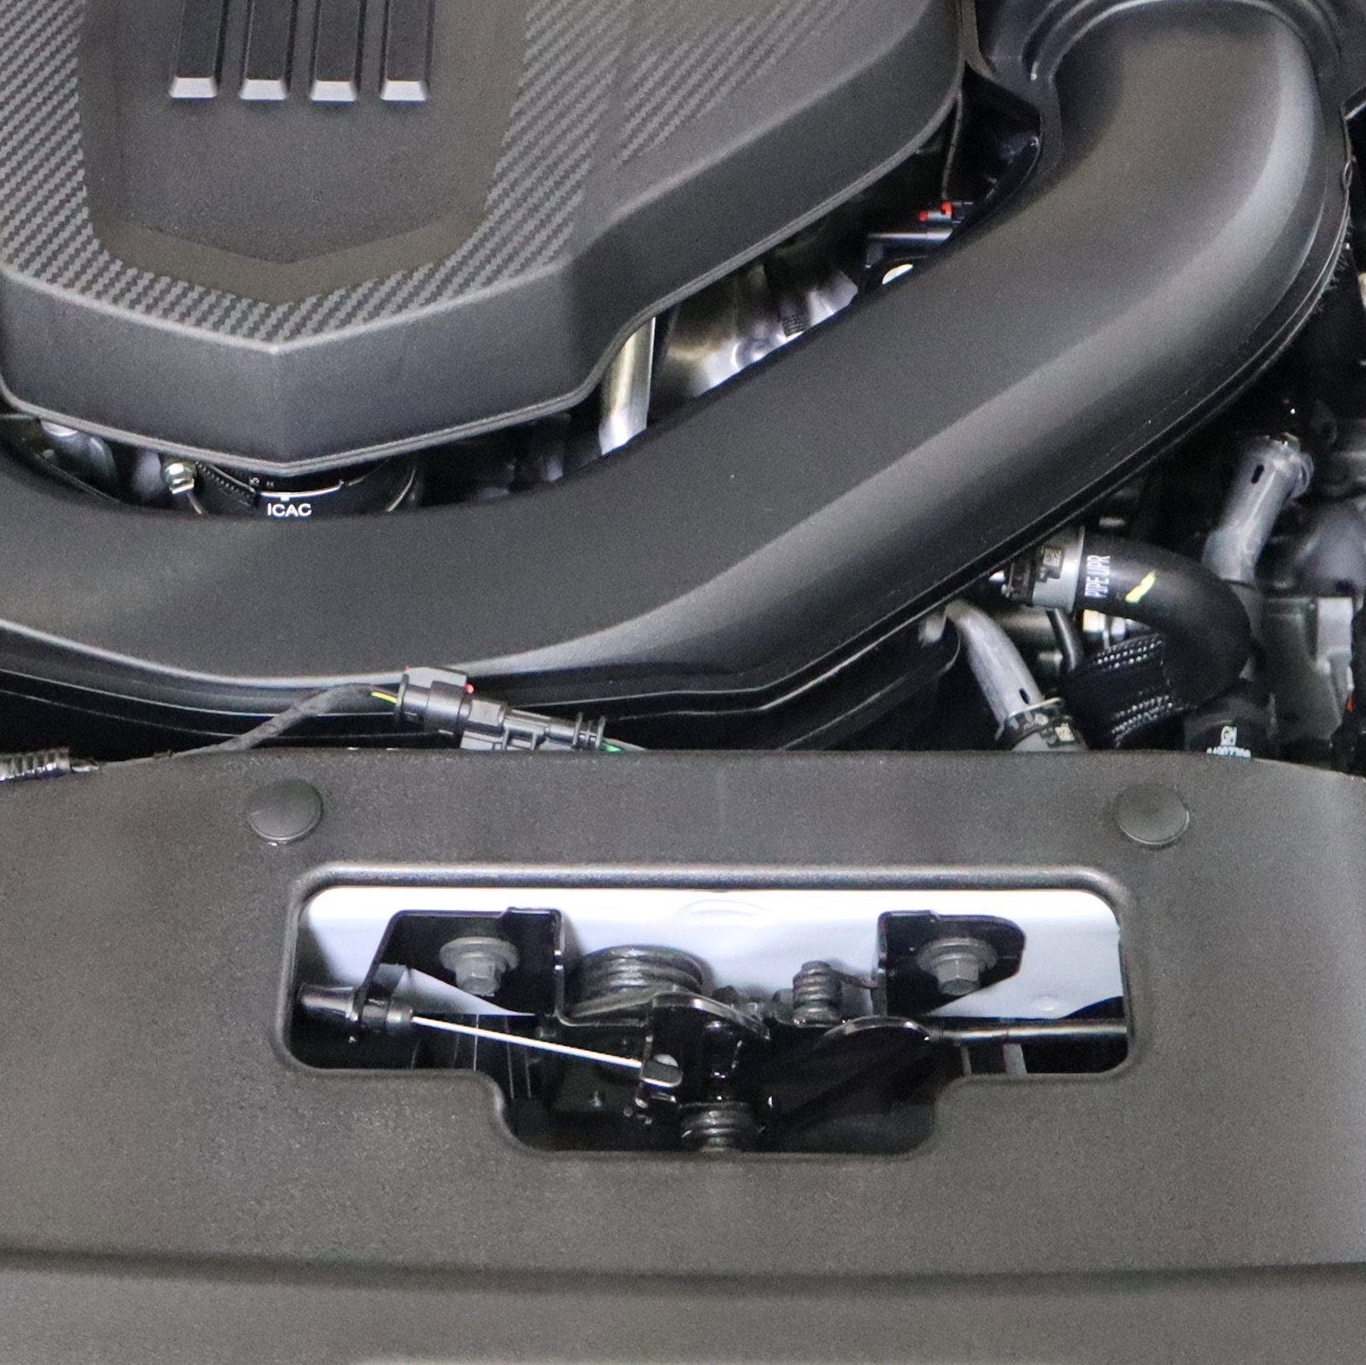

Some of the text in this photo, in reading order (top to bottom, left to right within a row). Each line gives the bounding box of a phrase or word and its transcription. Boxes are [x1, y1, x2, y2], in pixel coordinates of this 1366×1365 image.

[267, 502, 312, 518] ICAC
[1084, 555, 1110, 598] PIPE UPR
